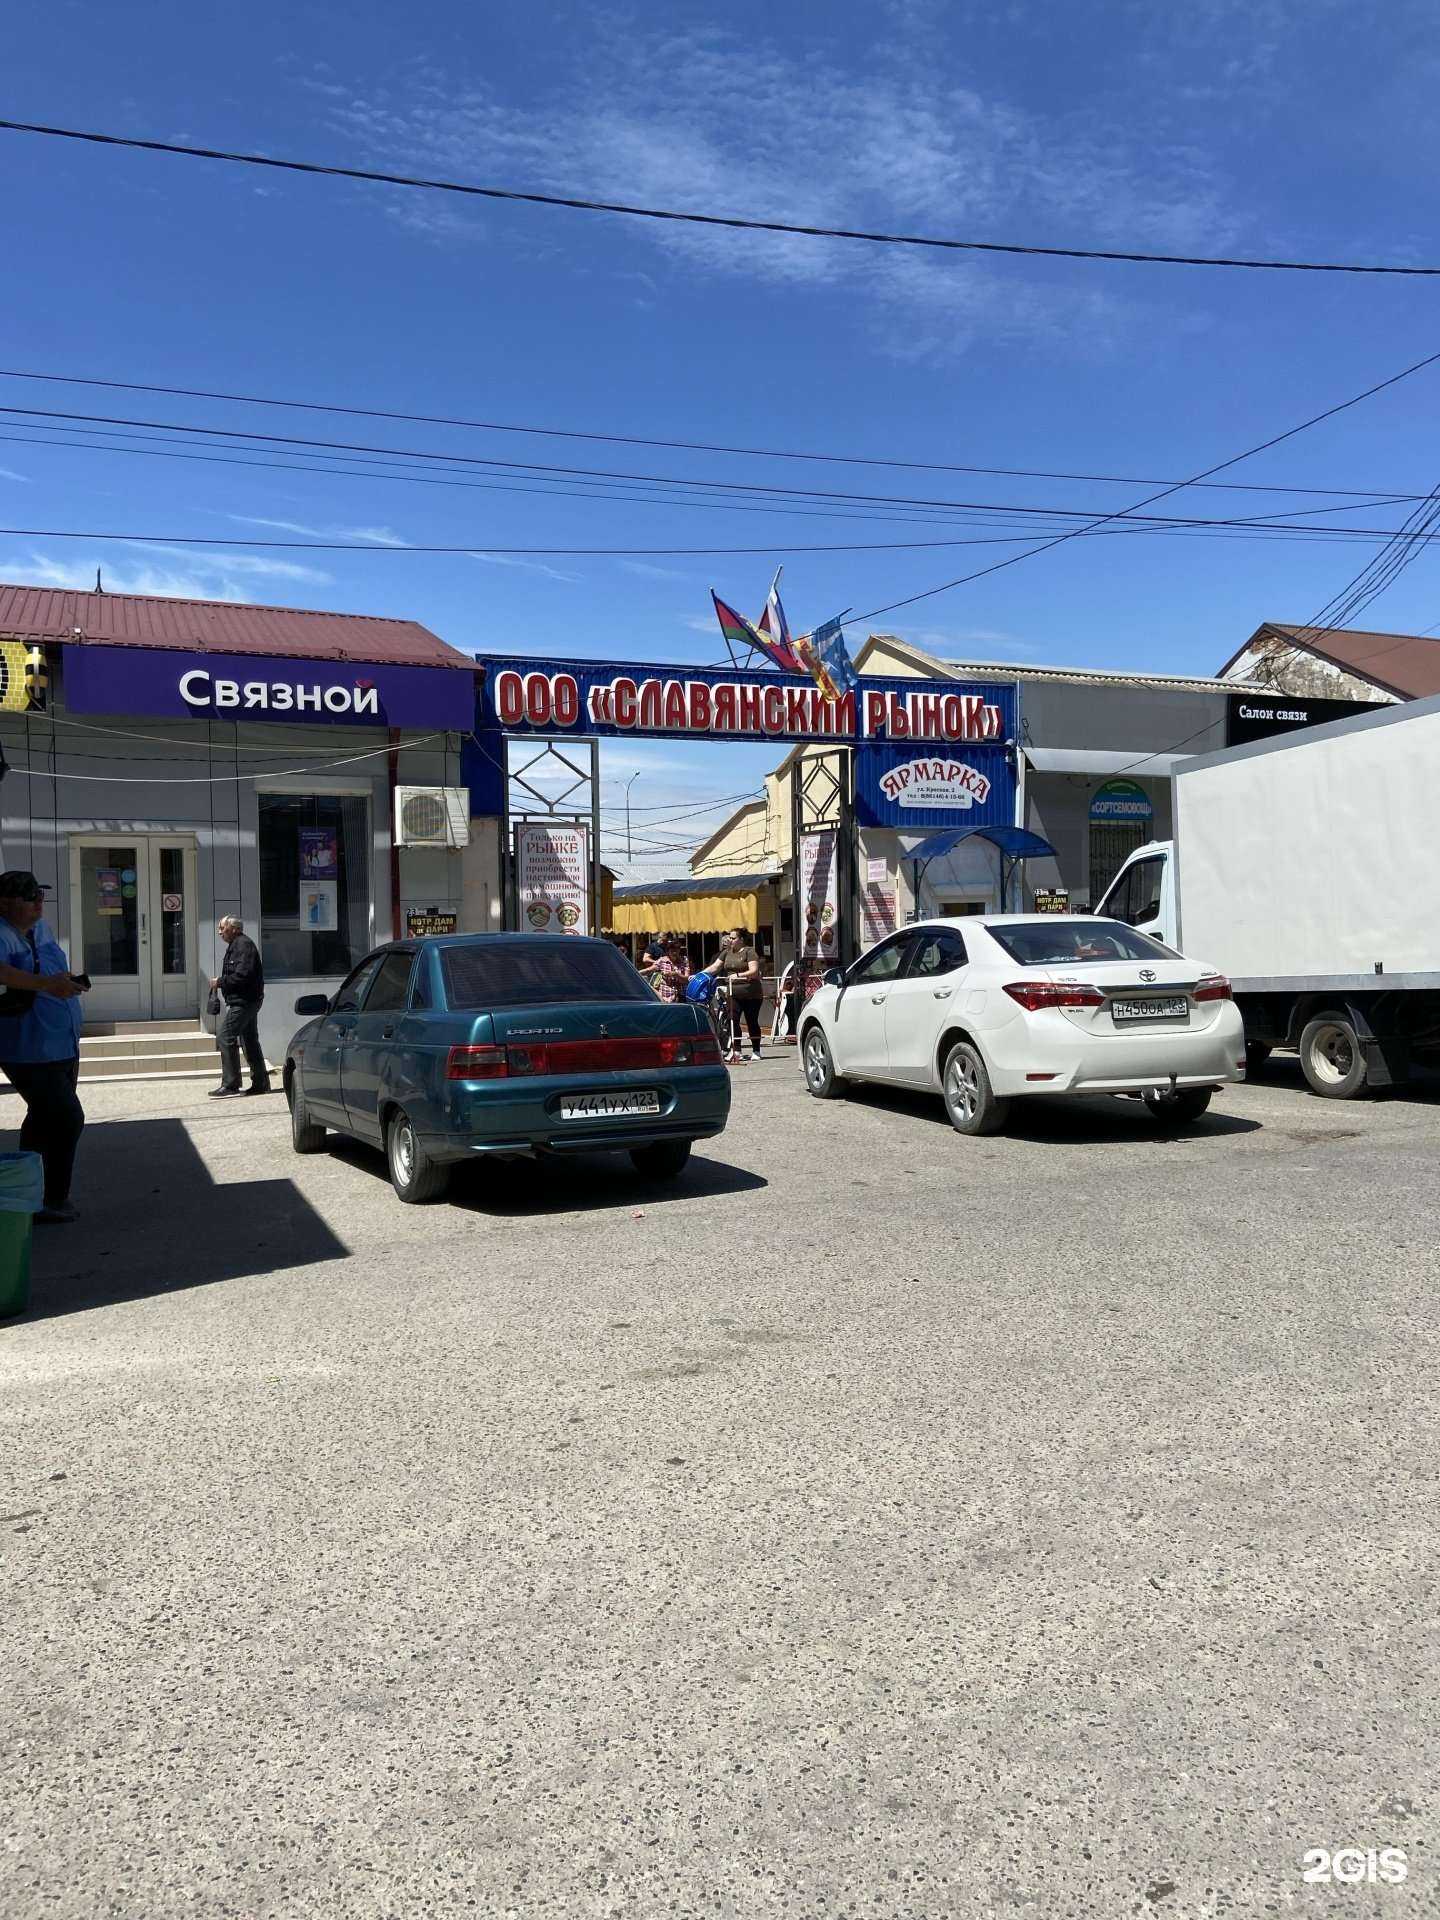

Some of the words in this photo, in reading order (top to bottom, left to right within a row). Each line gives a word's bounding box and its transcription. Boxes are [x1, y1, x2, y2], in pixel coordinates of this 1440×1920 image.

[495, 670, 579, 727] ООО
[862, 690, 1003, 742] РЫНОК»
[1239, 705, 1274, 720] Салон
[1276, 710, 1308, 722] связи
[883, 761, 988, 800] ЯРМАРКА
[530, 833, 563, 842] Только
[527, 842, 579, 854] РЫНКЕ
[631, 1093, 655, 1106] 123
